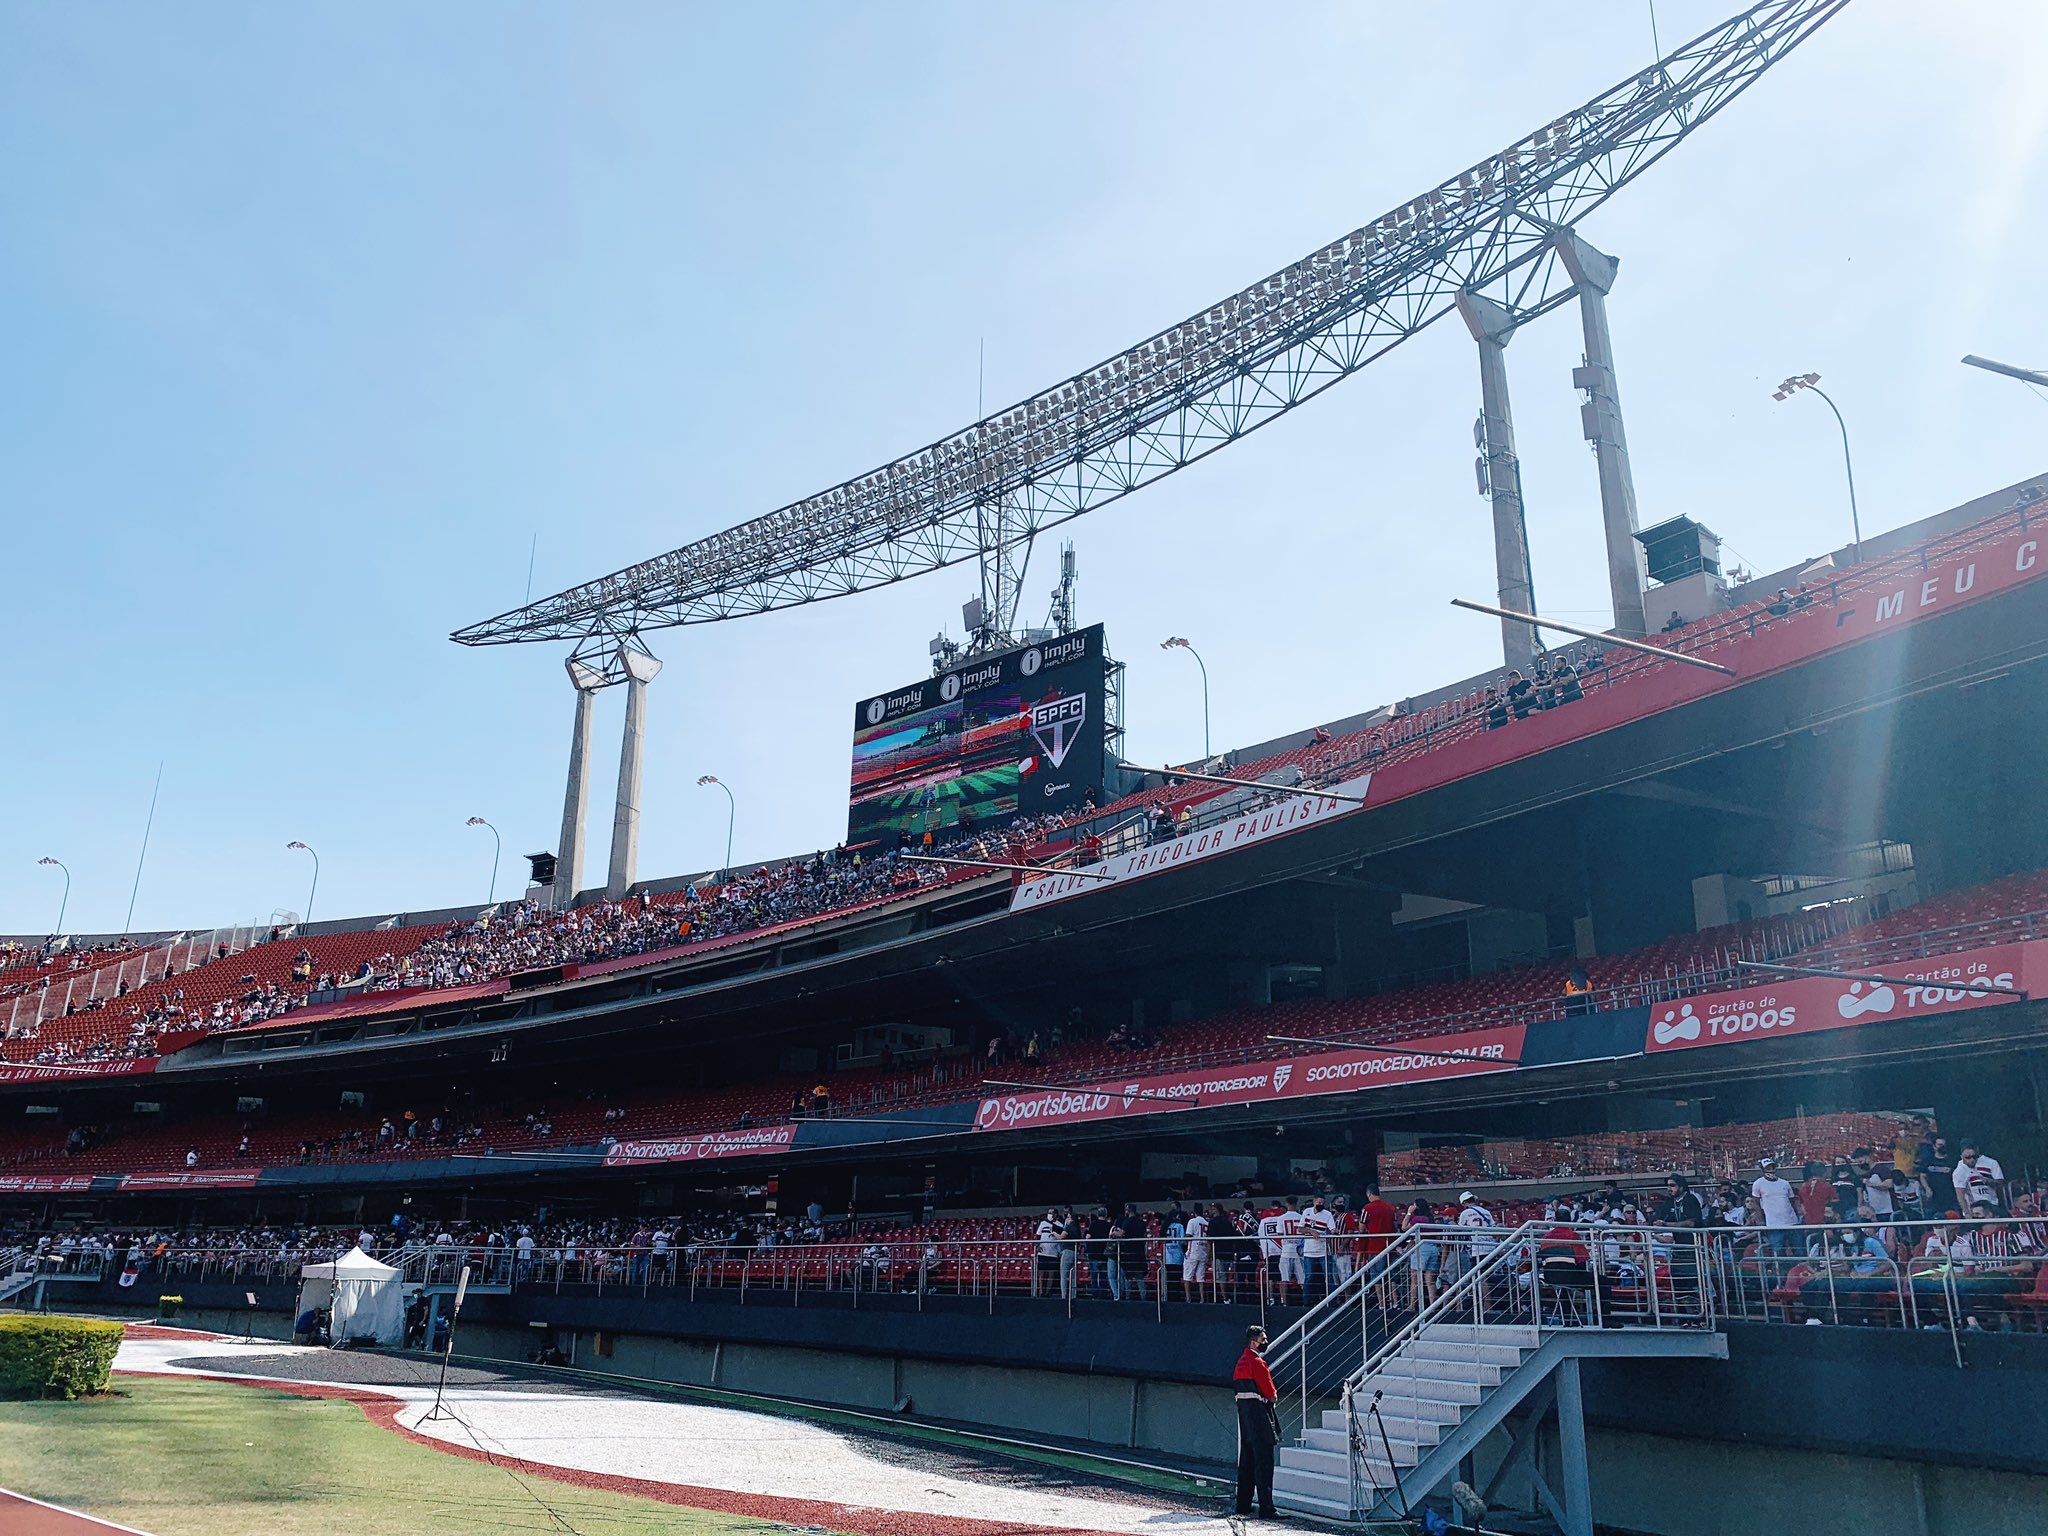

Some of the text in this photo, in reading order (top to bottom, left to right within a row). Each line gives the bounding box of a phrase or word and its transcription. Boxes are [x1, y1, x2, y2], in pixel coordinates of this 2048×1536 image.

[1875, 564, 1975, 623] MEU
[1044, 636, 1085, 660] imply
[1044, 651, 1085, 668] IMPLY.COM
[962, 664, 1000, 686] imply
[962, 679, 1000, 694] IMPLY.COM
[887, 689, 922, 710] imply
[887, 702, 922, 717] IMPLY.COM
[1038, 700, 1080, 725] SPFC
[1036, 792, 1339, 899] SALVE O TRICOLOR PAULISTA
[1905, 962, 1988, 982] Cartão de
[1903, 973, 2014, 1008] TODOS
[1709, 996, 1776, 1016] Cartão de
[1707, 1006, 1796, 1036] TODOS
[1167, 1081, 1201, 1098] SÓCIO
[1203, 1075, 1268, 1093] TORCEDOR!
[1001, 1088, 1110, 1125] Sportsbet.io
